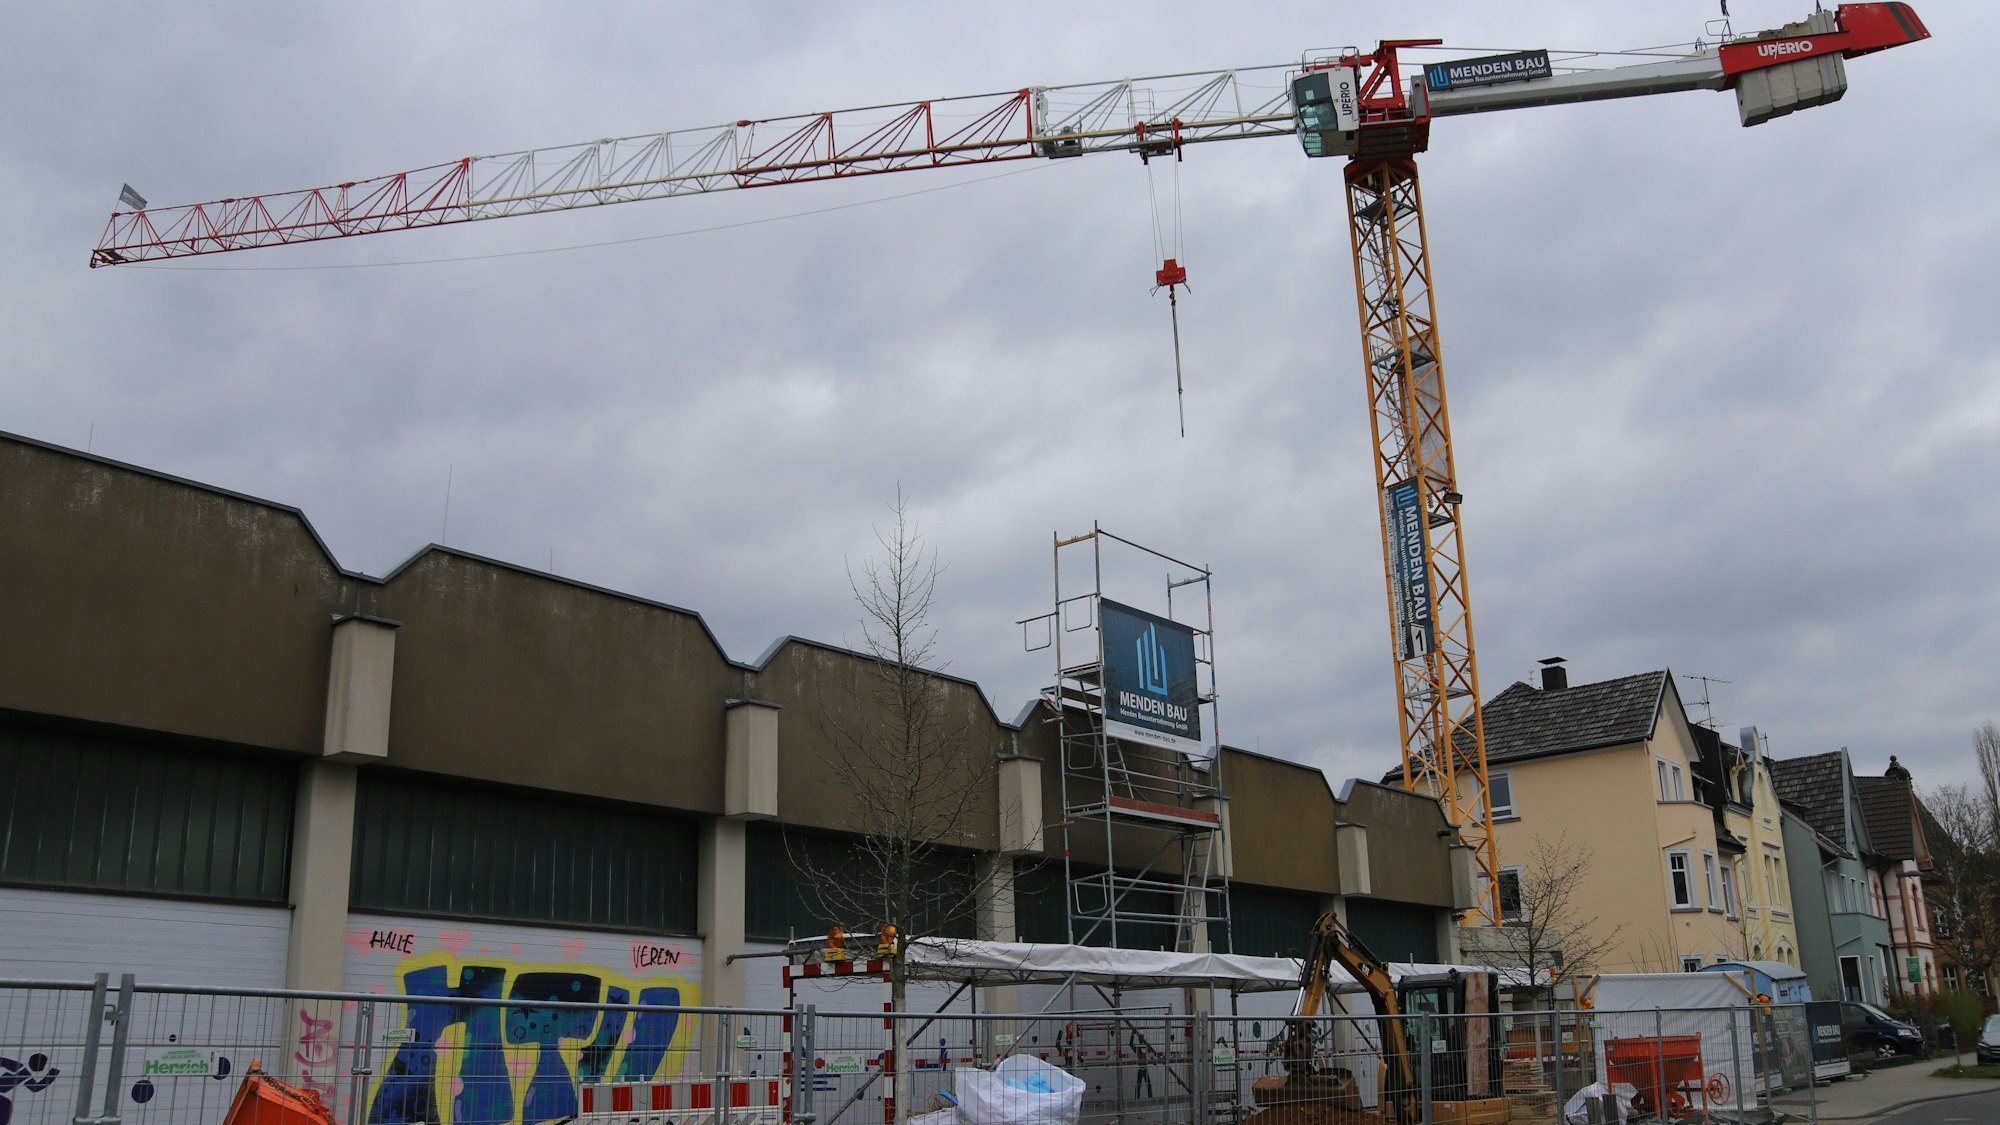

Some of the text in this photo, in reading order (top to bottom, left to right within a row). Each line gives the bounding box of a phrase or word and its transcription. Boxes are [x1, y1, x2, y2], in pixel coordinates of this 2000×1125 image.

[1450, 56, 1545, 79] MENDEN BAU
[1451, 67, 1547, 85] Menden Bauunternehmung GmbH
[1340, 81, 1351, 116] UPERIO
[1405, 505, 1427, 620] MENDEN BAU
[1401, 537, 1412, 601] Bauunternehmung
[1407, 601, 1415, 623] GmbH
[1415, 630, 1423, 652] 1
[1120, 691, 1187, 721] MENDEN BAU
[1120, 708, 1188, 731] Menden Bauunternehmung GmbH
[369, 930, 414, 954] HALLE
[145, 1060, 209, 1074] Henrich
[826, 1063, 860, 1073] Henrich
